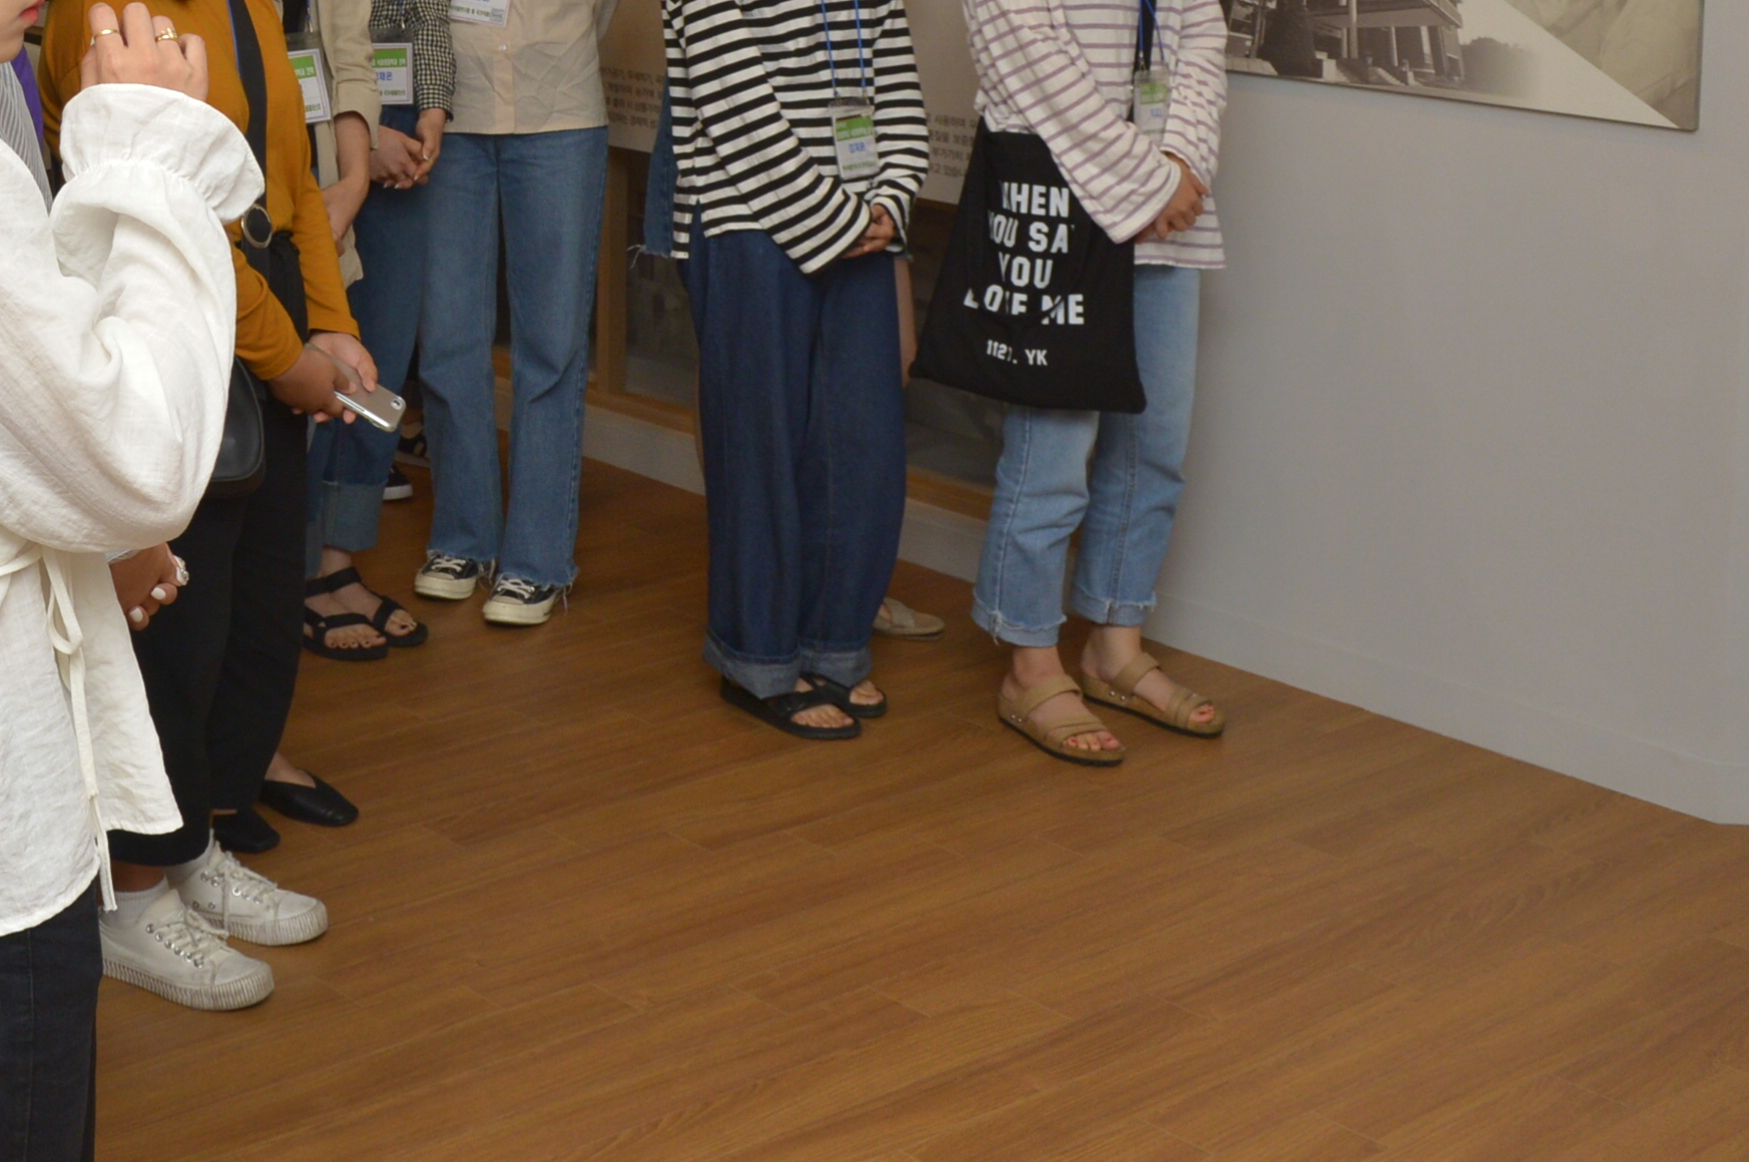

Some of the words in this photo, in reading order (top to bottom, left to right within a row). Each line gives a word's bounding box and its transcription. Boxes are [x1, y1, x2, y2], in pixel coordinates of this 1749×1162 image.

[1028, 221, 1075, 254] SA
[999, 252, 1053, 289] YOU
[1041, 294, 1084, 325] ME
[1024, 349, 1048, 366] YK
